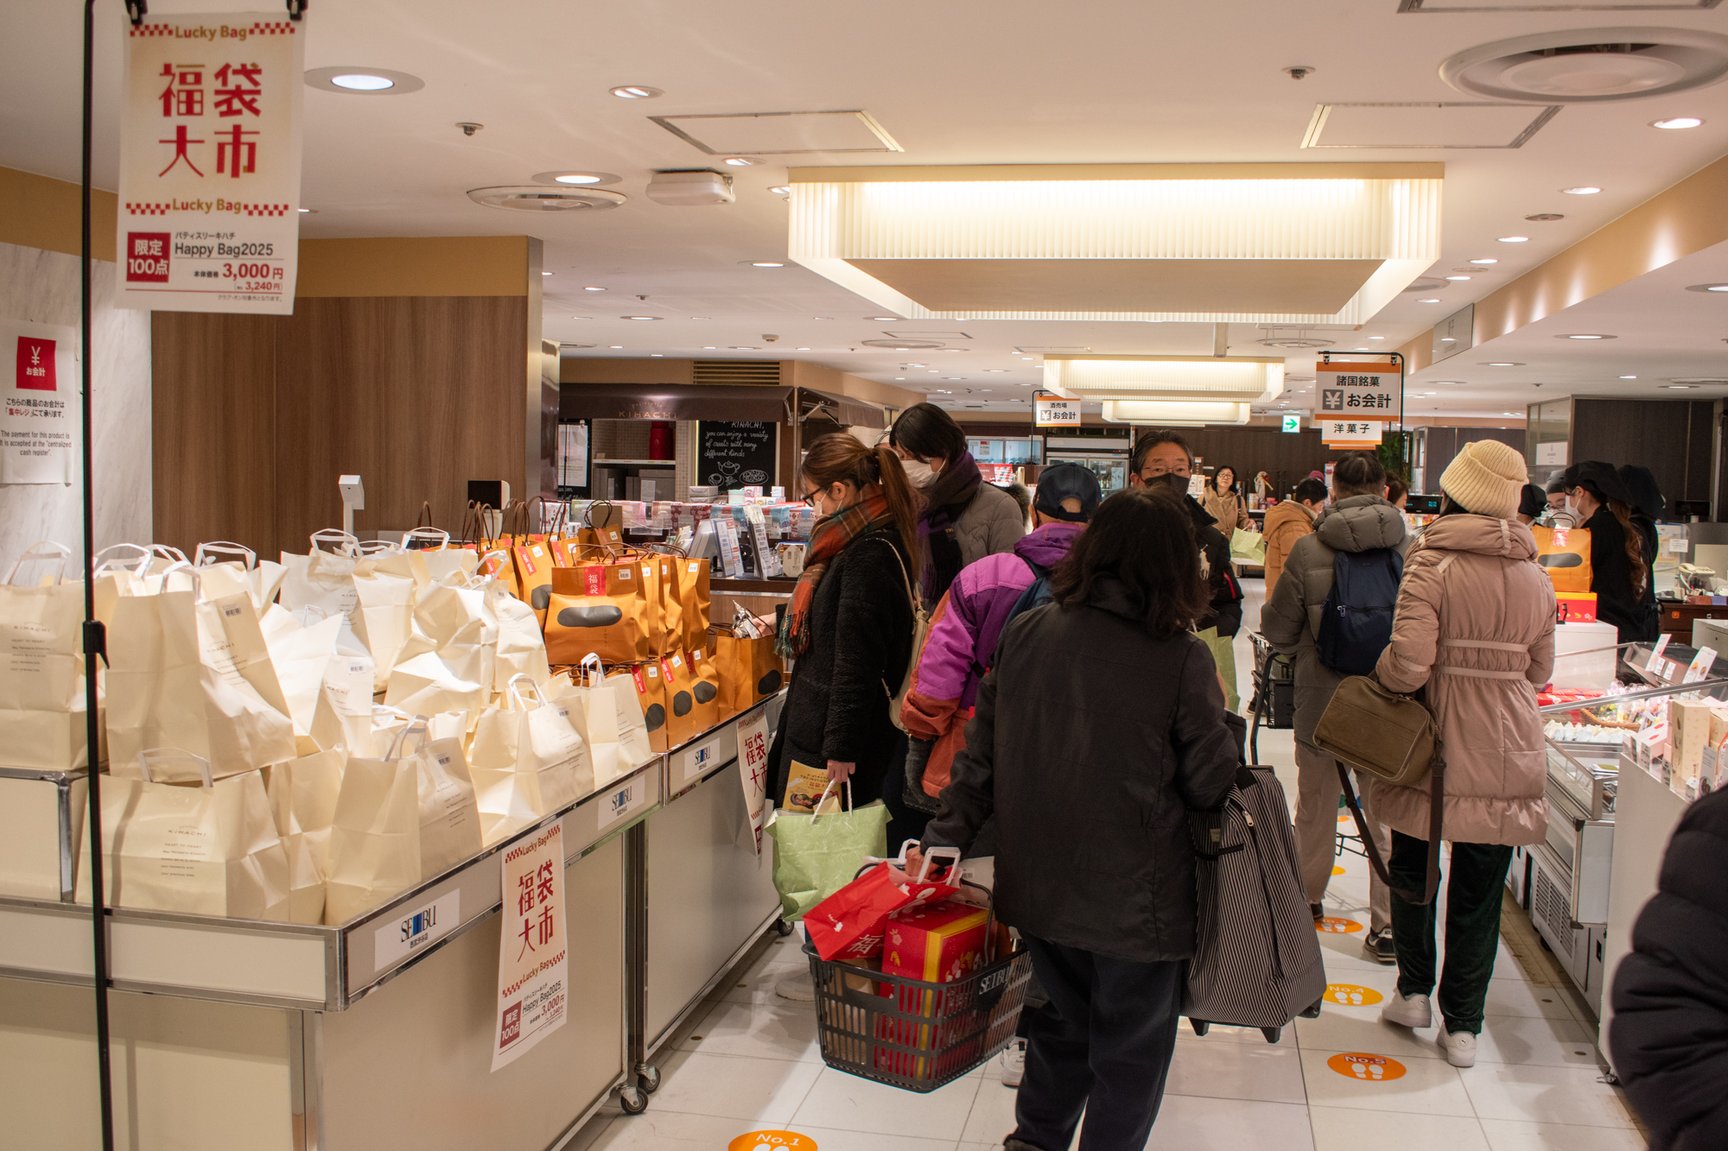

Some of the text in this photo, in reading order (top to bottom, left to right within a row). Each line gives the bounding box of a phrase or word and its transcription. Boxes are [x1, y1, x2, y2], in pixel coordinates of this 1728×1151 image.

[174, 25, 247, 41] Lucky Bag
[158, 62, 263, 118] 福袋
[158, 124, 261, 179] 大市
[172, 198, 242, 215] Lucky Bag
[134, 239, 163, 256] 限定
[174, 242, 274, 258] Happy Bag2025
[128, 258, 169, 276] 100点
[26, 367, 46, 377] お会計
[1336, 375, 1381, 387] 諸国銘菓
[1347, 393, 1392, 408] お会計
[1053, 411, 1076, 420] お会計
[1, 430, 10, 438] The
[11, 431, 31, 439] payment
[31, 431, 39, 439] for
[1333, 423, 1370, 434] 洋菓子
[10, 440, 31, 448] accepted
[588, 574, 599, 594] 福袋
[522, 834, 548, 857] Lucky Bag
[518, 859, 554, 917] 福袋
[517, 905, 554, 963] 大市
[522, 961, 550, 983] Lucky Bag
[1329, 986, 1364, 994] No.4
[1344, 1055, 1386, 1065] No.5
[756, 1133, 800, 1146] No.1
